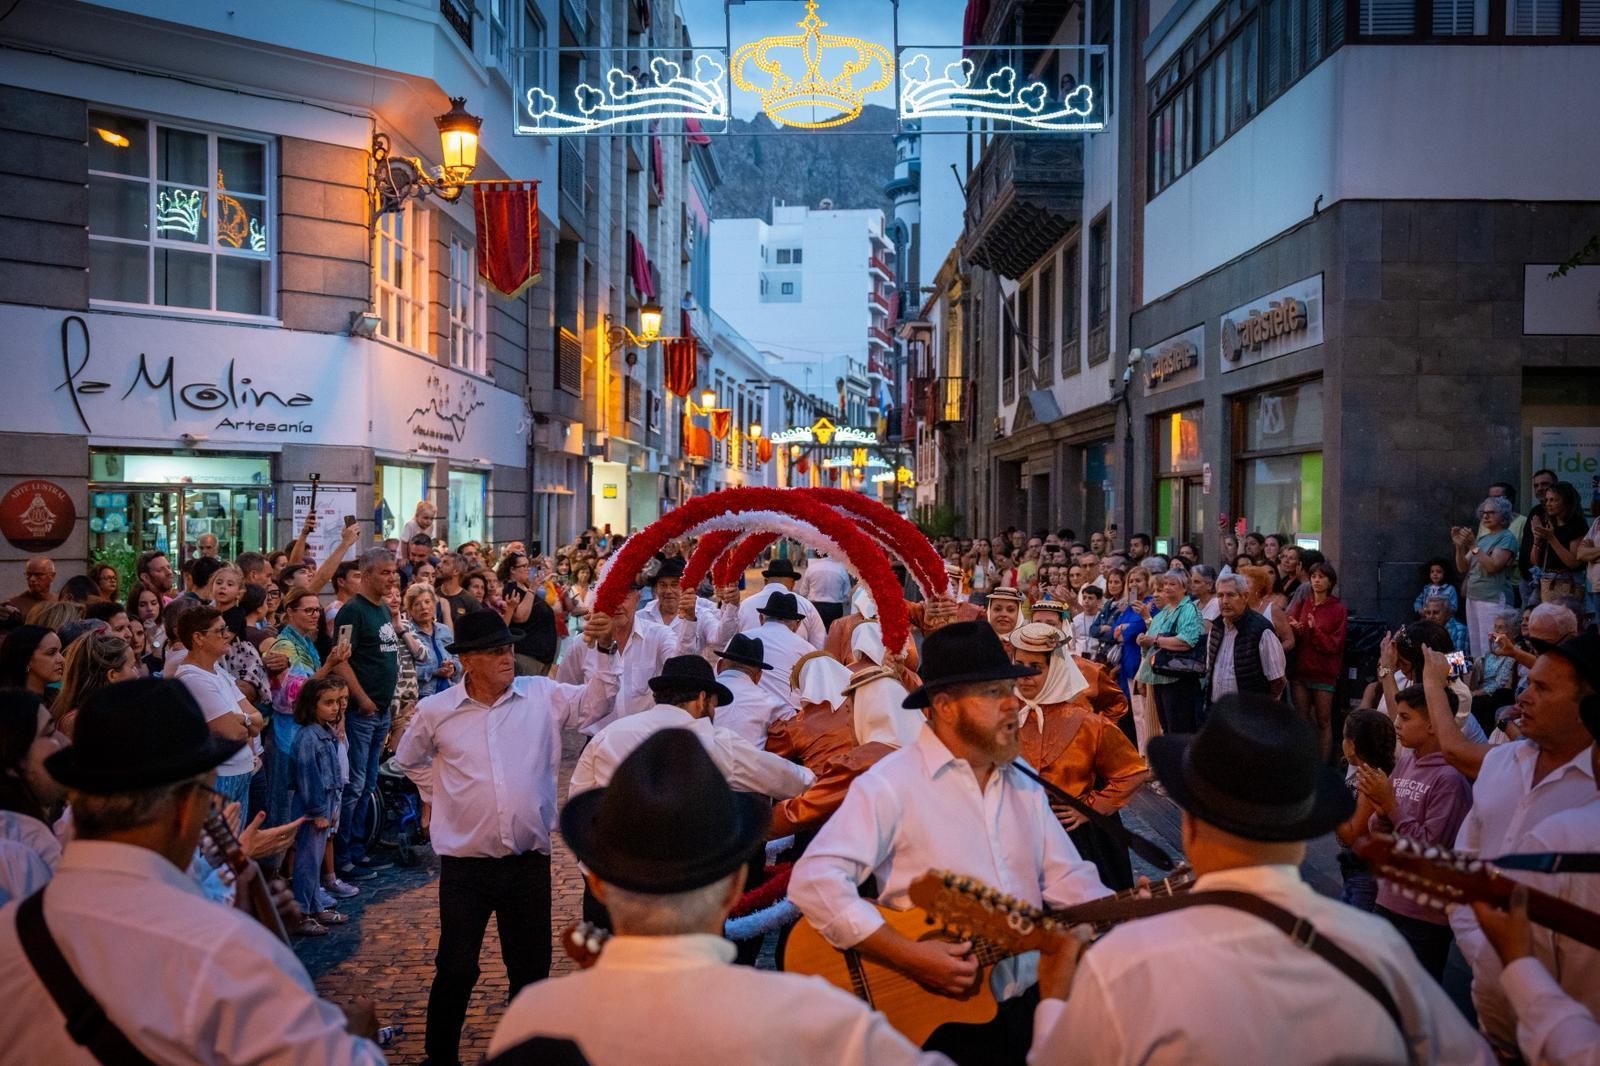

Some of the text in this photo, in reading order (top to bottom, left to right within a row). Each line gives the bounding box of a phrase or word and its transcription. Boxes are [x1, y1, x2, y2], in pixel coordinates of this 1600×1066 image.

[55, 316, 314, 434] La Molina
[215, 418, 313, 432] Artesanía
